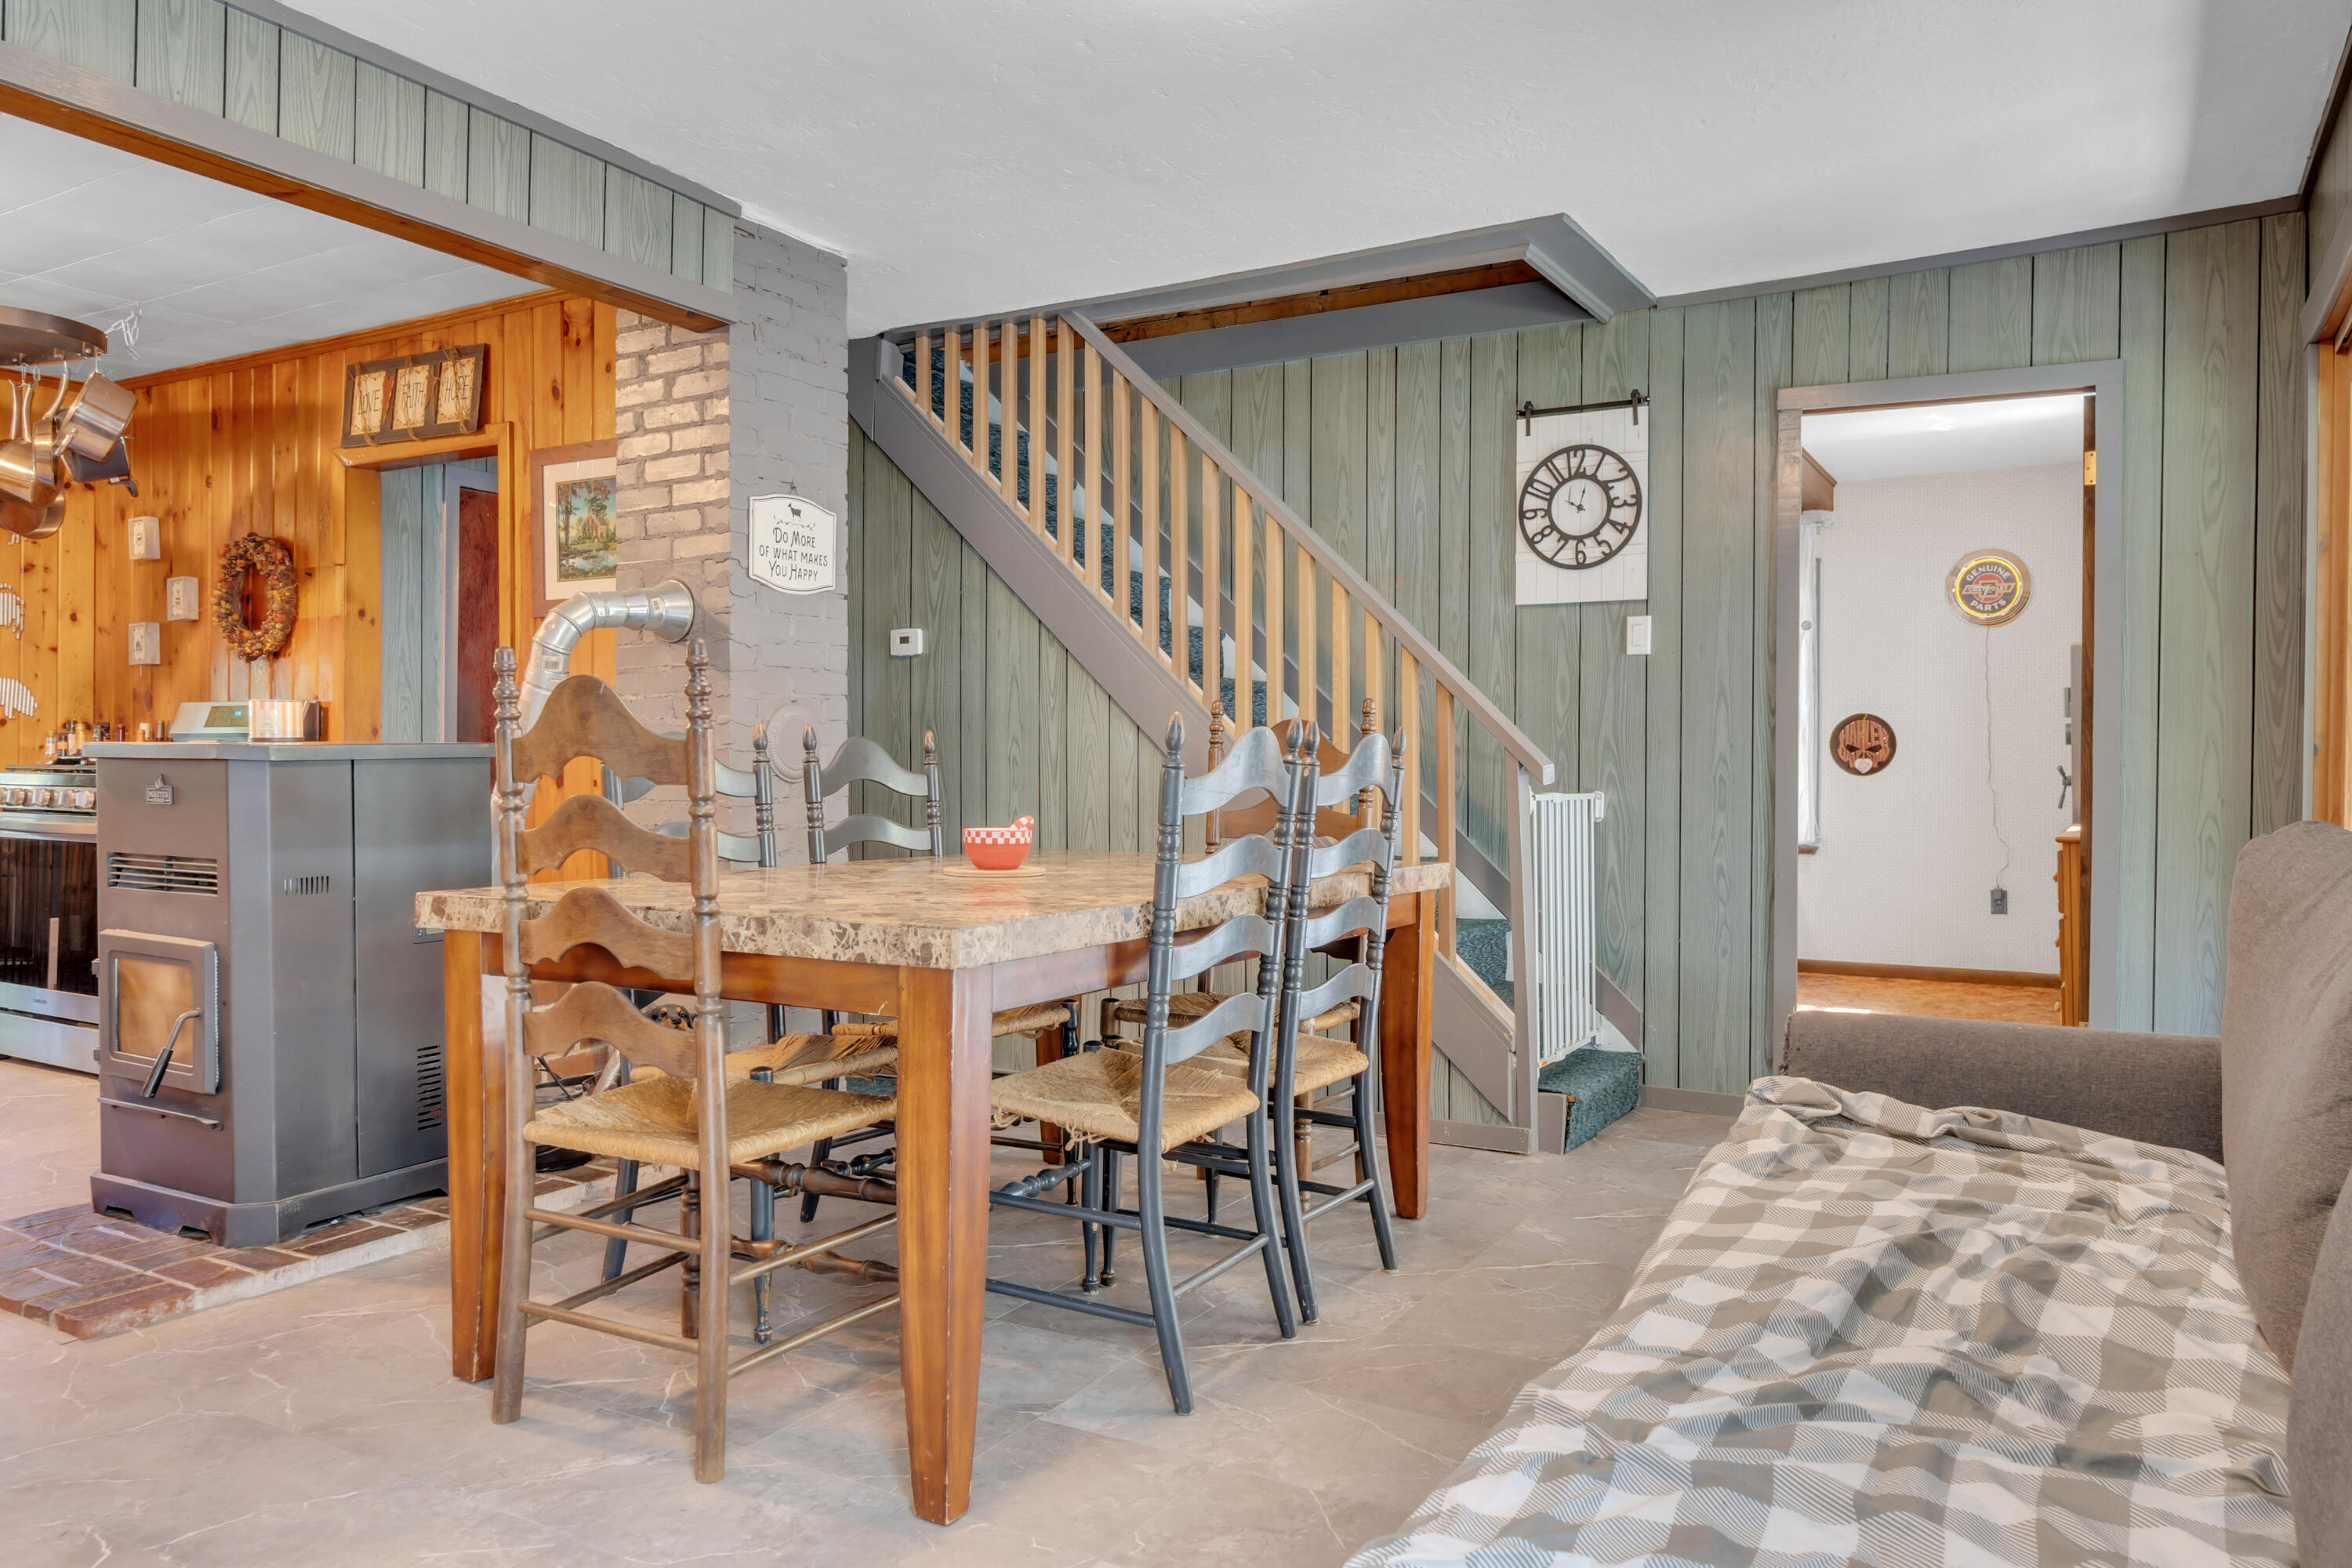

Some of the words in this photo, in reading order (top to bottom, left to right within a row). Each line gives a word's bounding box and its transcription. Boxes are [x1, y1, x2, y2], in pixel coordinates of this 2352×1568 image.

[401, 382, 425, 409] FAITH
[444, 376, 470, 403] HOPE
[358, 389, 381, 415] LOVE
[1567, 449, 1587, 477] 12
[1527, 479, 1553, 501] 10
[1613, 494, 1638, 507] 3
[1523, 509, 1547, 520] 9
[773, 527, 789, 543] DO
[790, 530, 815, 548] MORE
[1532, 525, 1553, 544] 8
[1608, 519, 1632, 535] 4
[759, 545, 770, 557] OF
[773, 546, 797, 562] WHAT
[800, 551, 828, 566] MAKES
[1552, 536, 1569, 559] 7
[1576, 540, 1587, 564] 6
[1593, 533, 1613, 557] 5
[768, 560, 787, 577] YOU
[789, 563, 818, 582] HAPPY
[1966, 564, 2011, 581] GENUINE
[1970, 598, 2007, 612] PARTS
